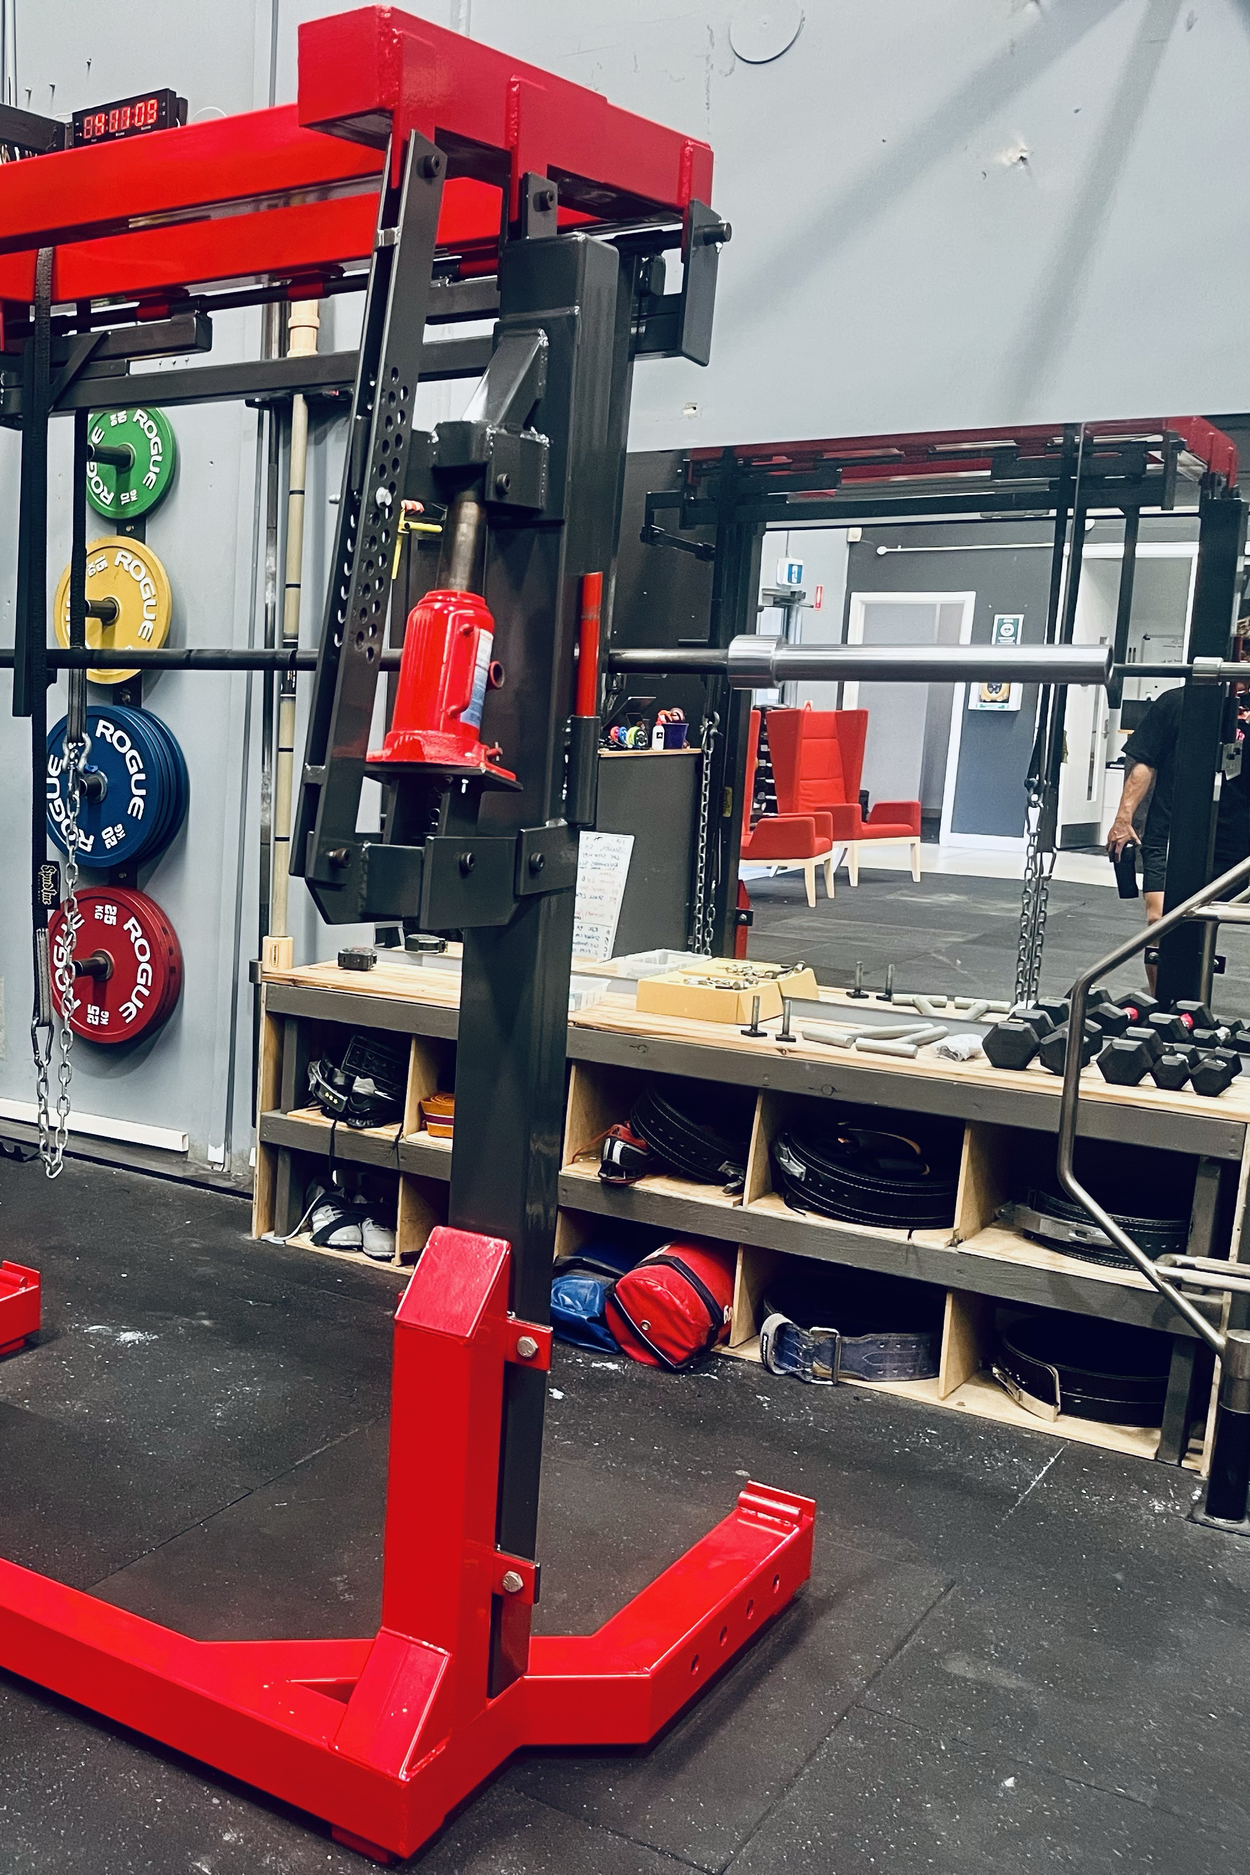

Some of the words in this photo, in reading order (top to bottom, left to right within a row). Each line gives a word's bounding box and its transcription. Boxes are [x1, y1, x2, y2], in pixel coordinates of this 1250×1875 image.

[132, 408, 163, 490] ROGUE
[86, 426, 114, 505] ROGE
[120, 492, 130, 506] 10
[86, 563, 97, 578] KG
[94, 554, 109, 573] 15
[114, 549, 158, 641] ROGUE
[95, 719, 147, 821] ROGUE
[101, 825, 119, 850] 20
[113, 823, 126, 840] KG
[94, 905, 104, 920] KG
[103, 904, 118, 926] 25
[118, 916, 153, 1024] ROGUE
[86, 1003, 100, 1026] 25
[100, 1010, 110, 1025] KG
